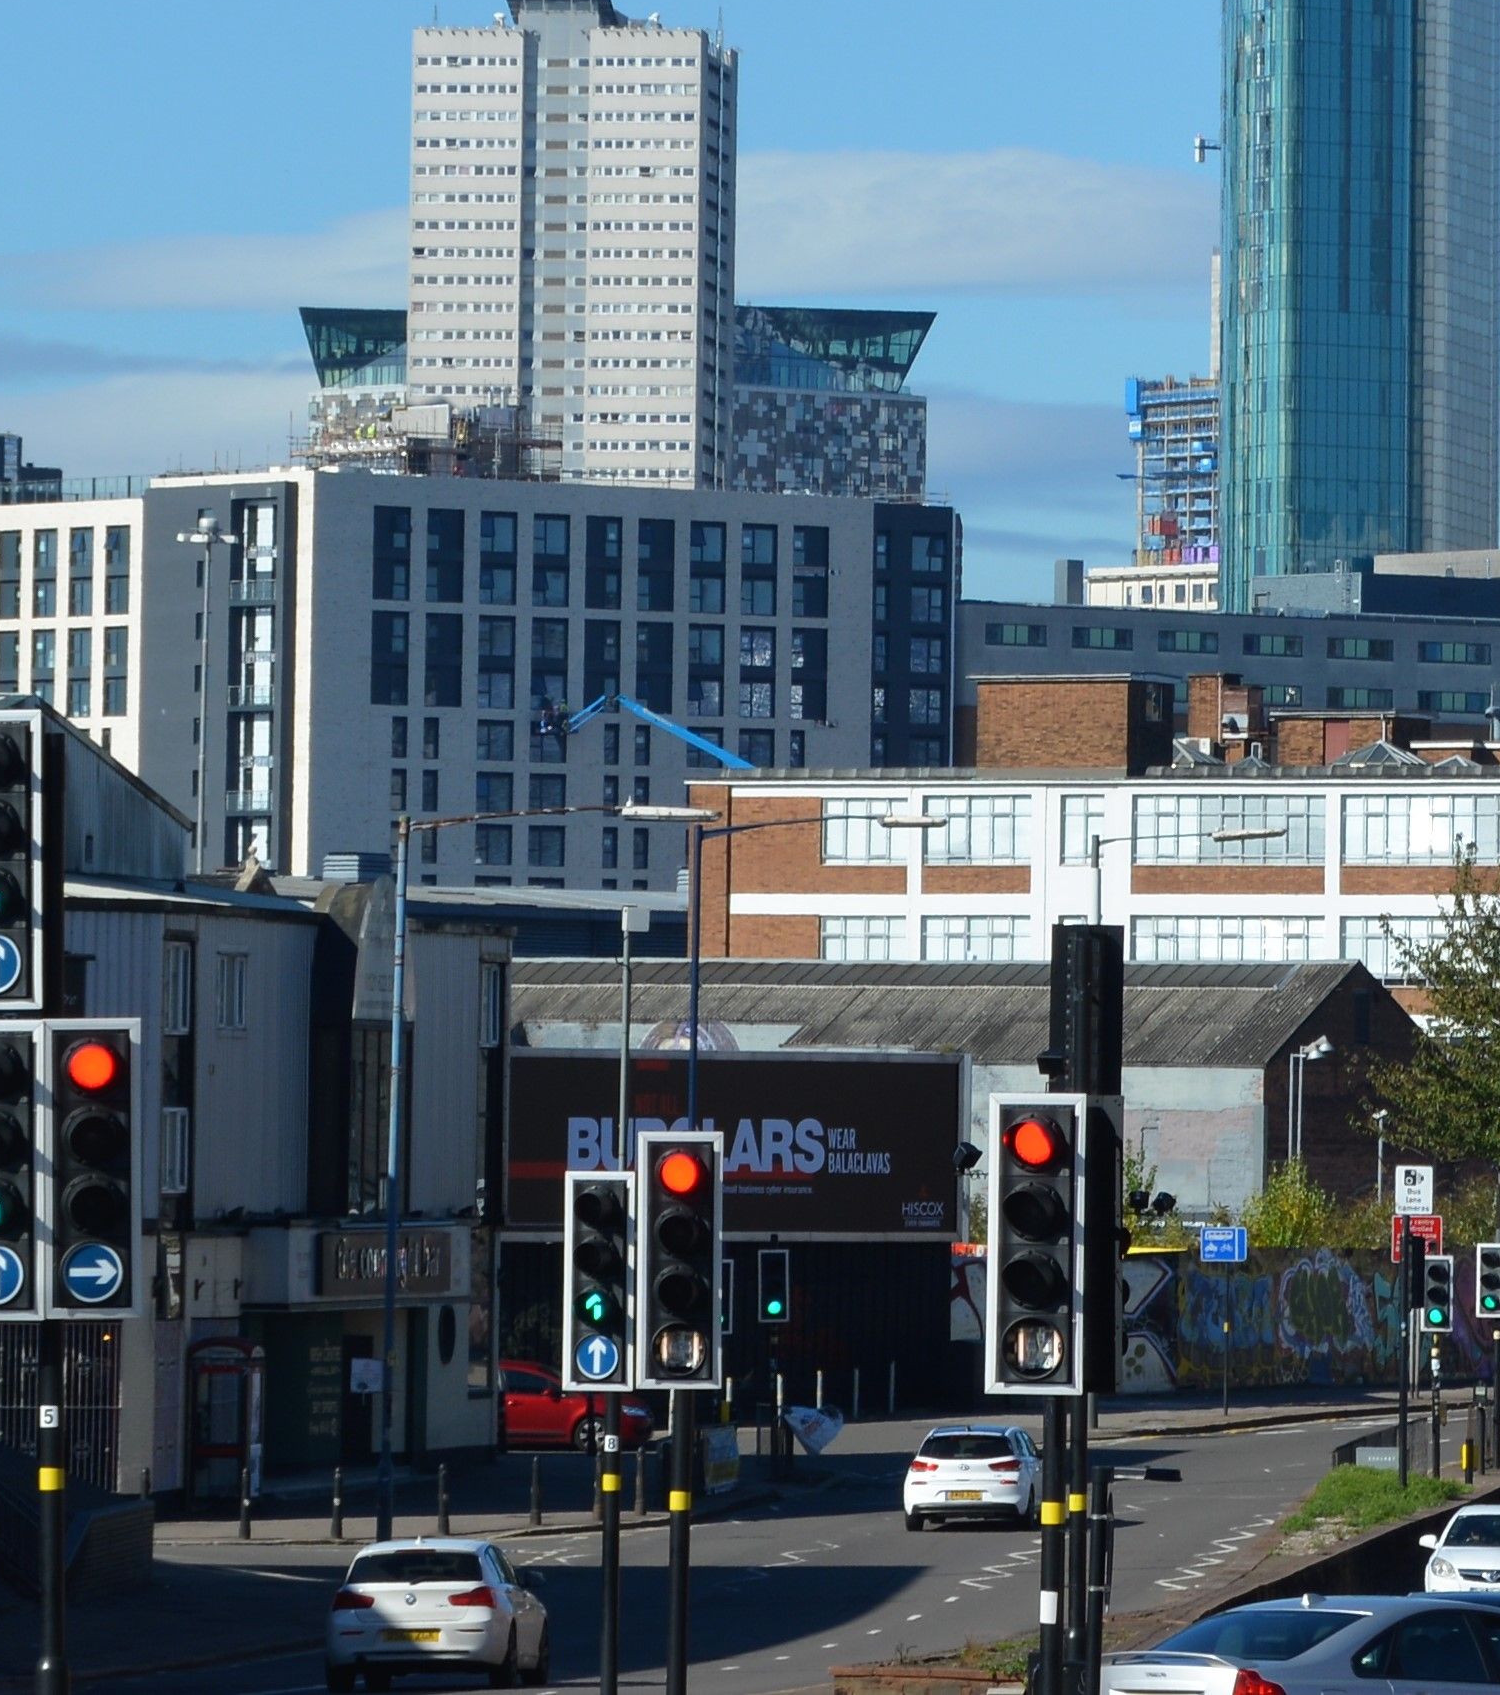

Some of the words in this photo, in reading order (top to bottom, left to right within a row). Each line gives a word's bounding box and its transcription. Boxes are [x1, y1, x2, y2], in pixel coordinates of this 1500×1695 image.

[567, 1117, 826, 1175] BUARS
[828, 1128, 858, 1150] WEAR
[828, 1152, 891, 1175] BALACLAVAS
[1407, 1187, 1422, 1195] Bus
[902, 1201, 944, 1216] HISCOX
[43, 1408, 54, 1425] 5
[607, 1438, 616, 1450] 8
